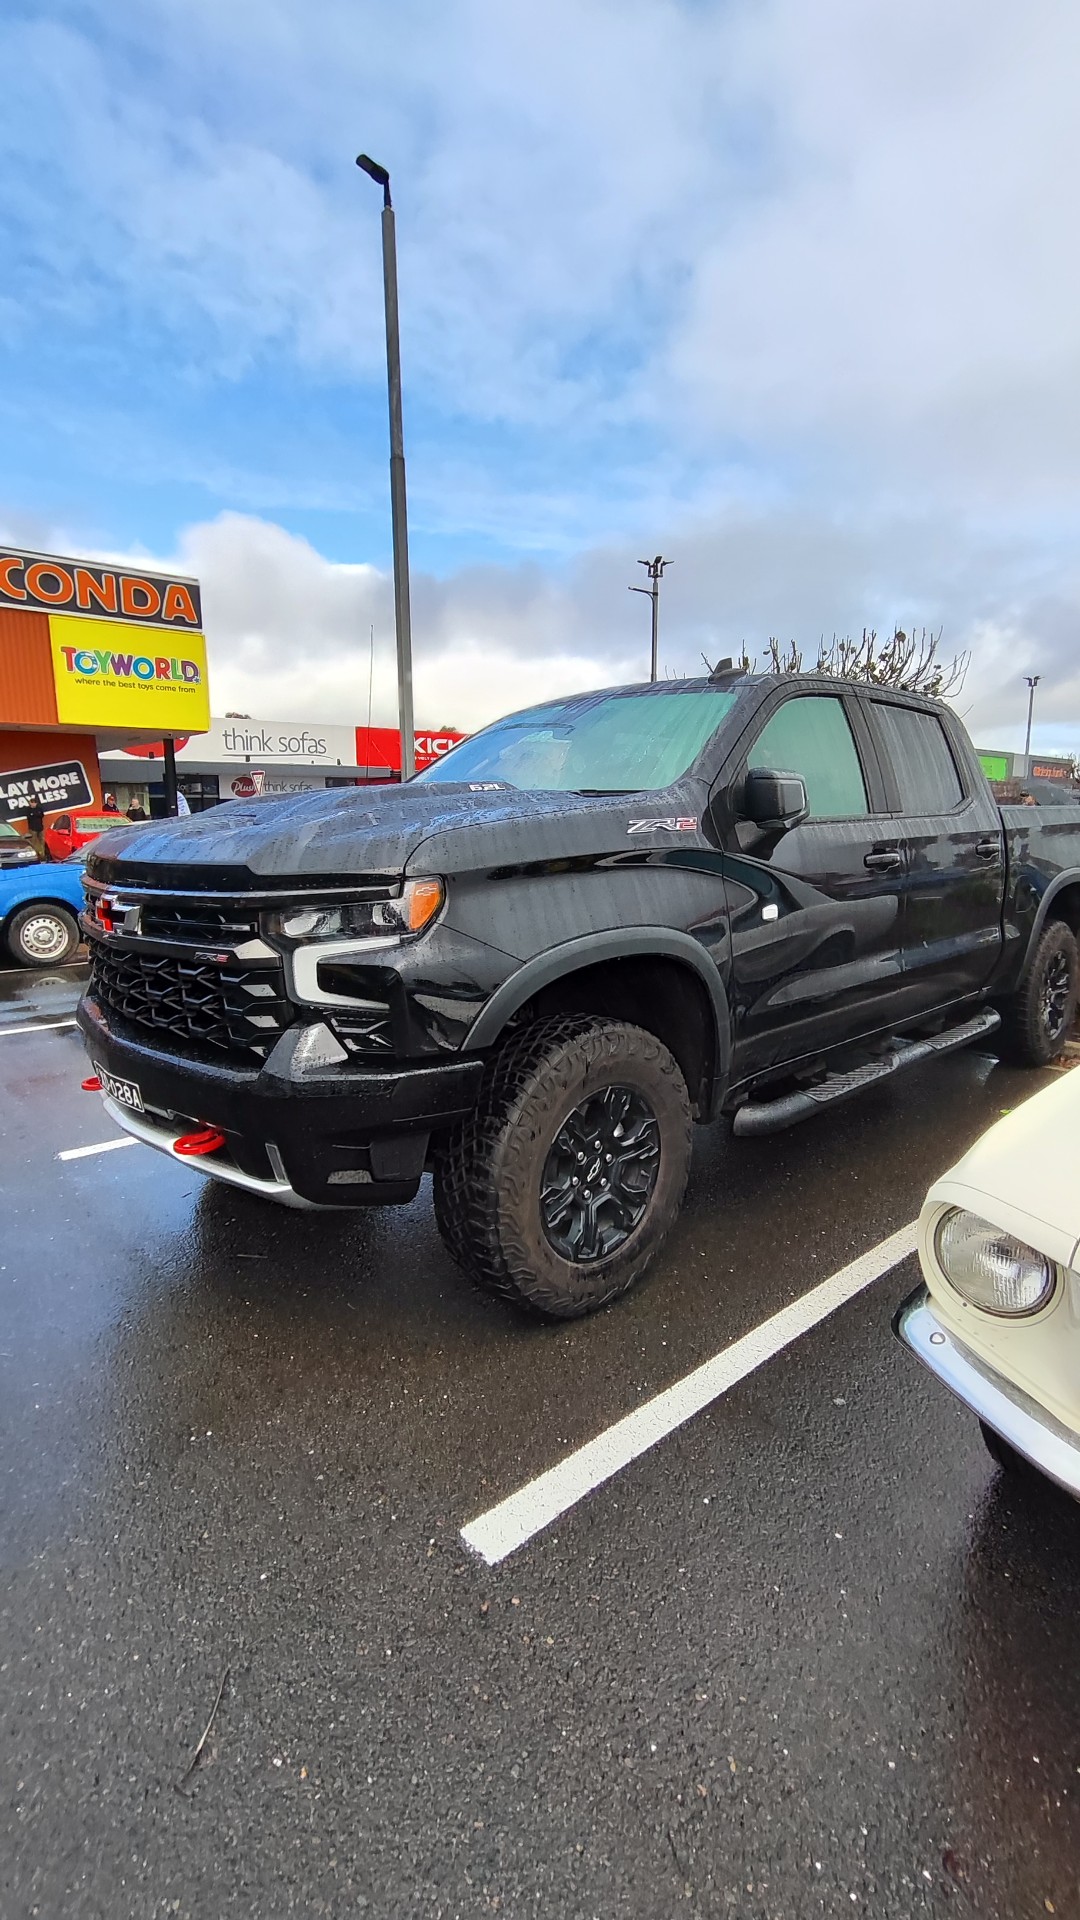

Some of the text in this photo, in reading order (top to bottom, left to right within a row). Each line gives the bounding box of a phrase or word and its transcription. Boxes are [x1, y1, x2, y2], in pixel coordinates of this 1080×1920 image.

[0, 557, 198, 624] CONDA
[61, 646, 199, 683] TOYWORLD
[74, 678, 100, 686] where
[103, 679, 116, 687] the
[138, 683, 154, 691] toys
[222, 728, 327, 754] think sofas
[32, 772, 81, 792] MORE
[264, 781, 287, 792] think
[38, 788, 68, 804] LESS
[626, 816, 698, 834] ZR2
